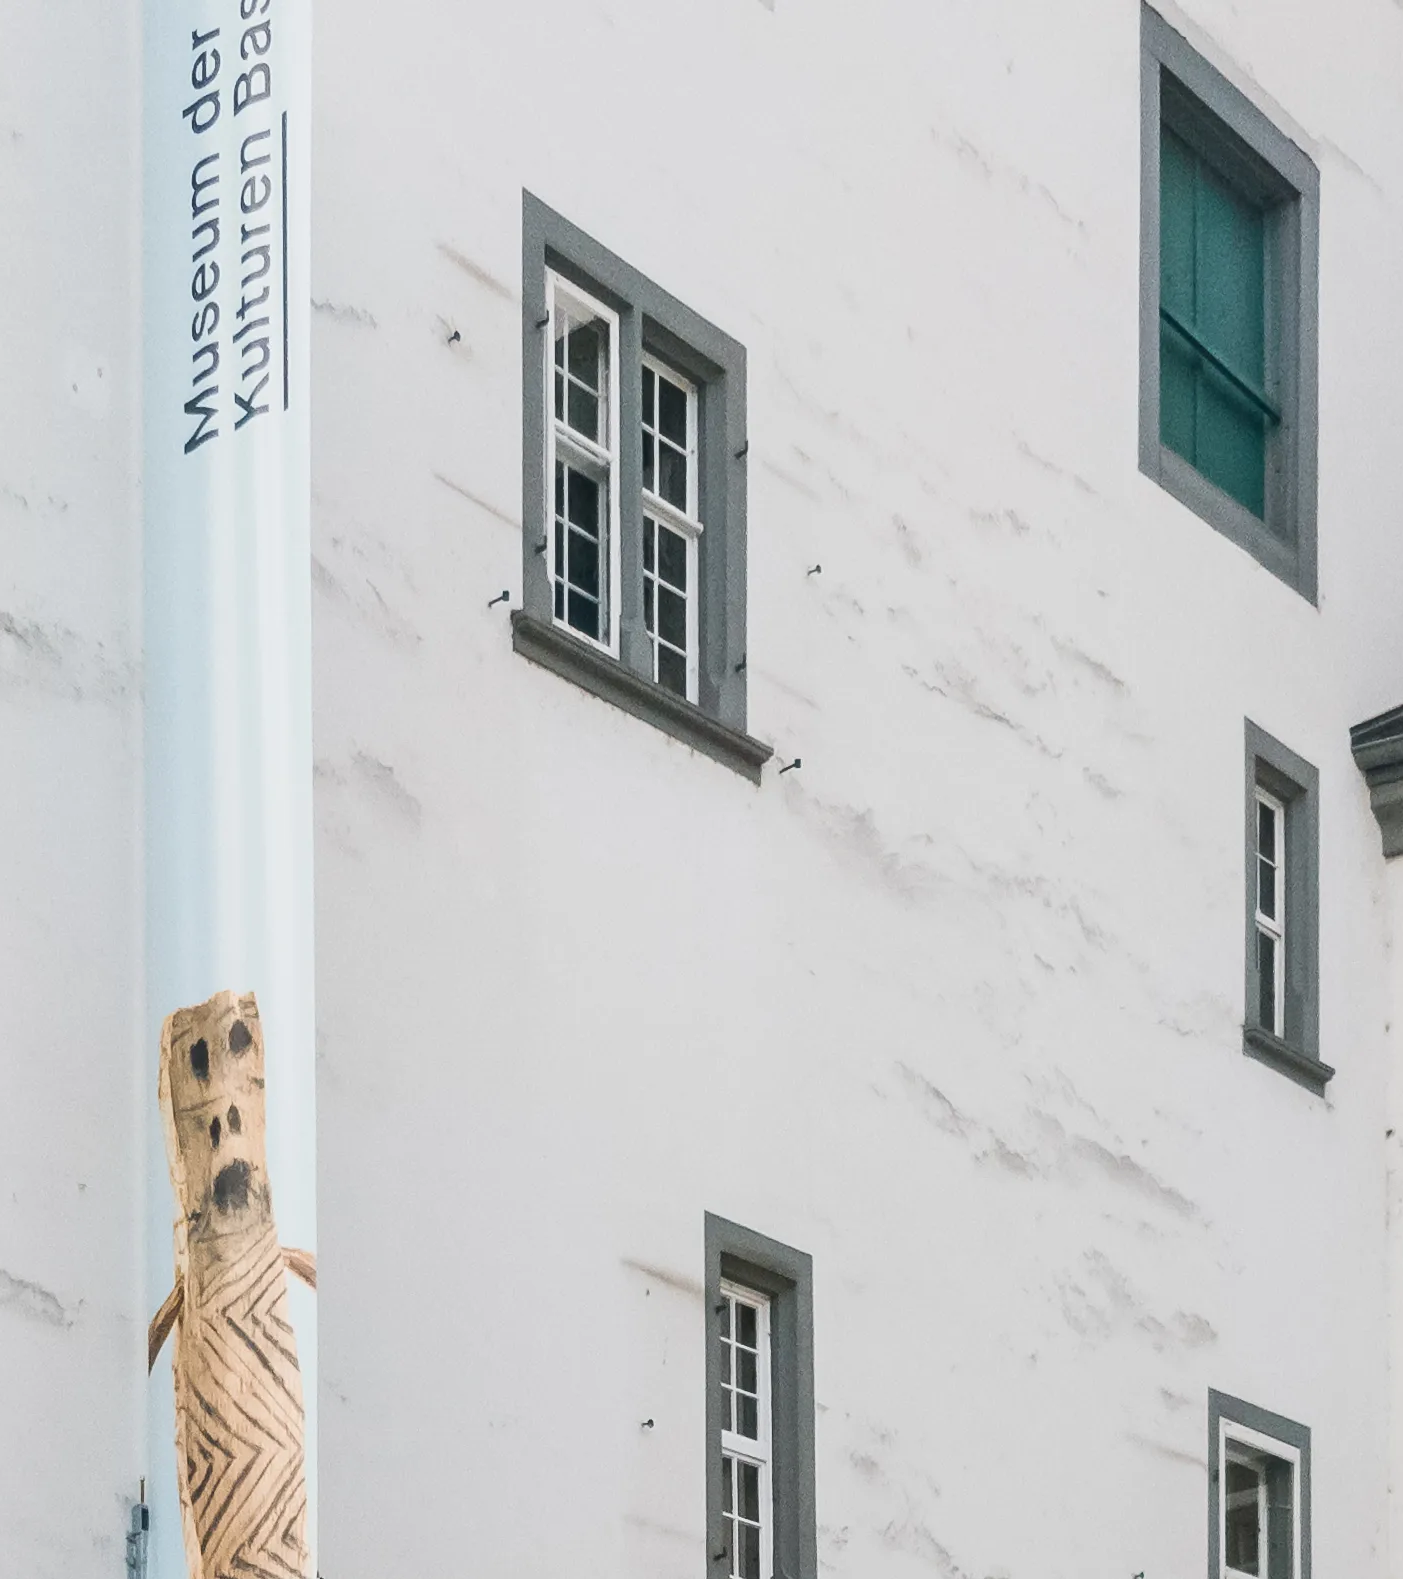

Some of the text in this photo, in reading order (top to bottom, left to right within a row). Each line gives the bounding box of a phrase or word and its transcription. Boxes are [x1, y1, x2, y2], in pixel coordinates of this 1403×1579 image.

[182, 27, 221, 455] Museum der
[232, 129, 271, 431] Kulturen
